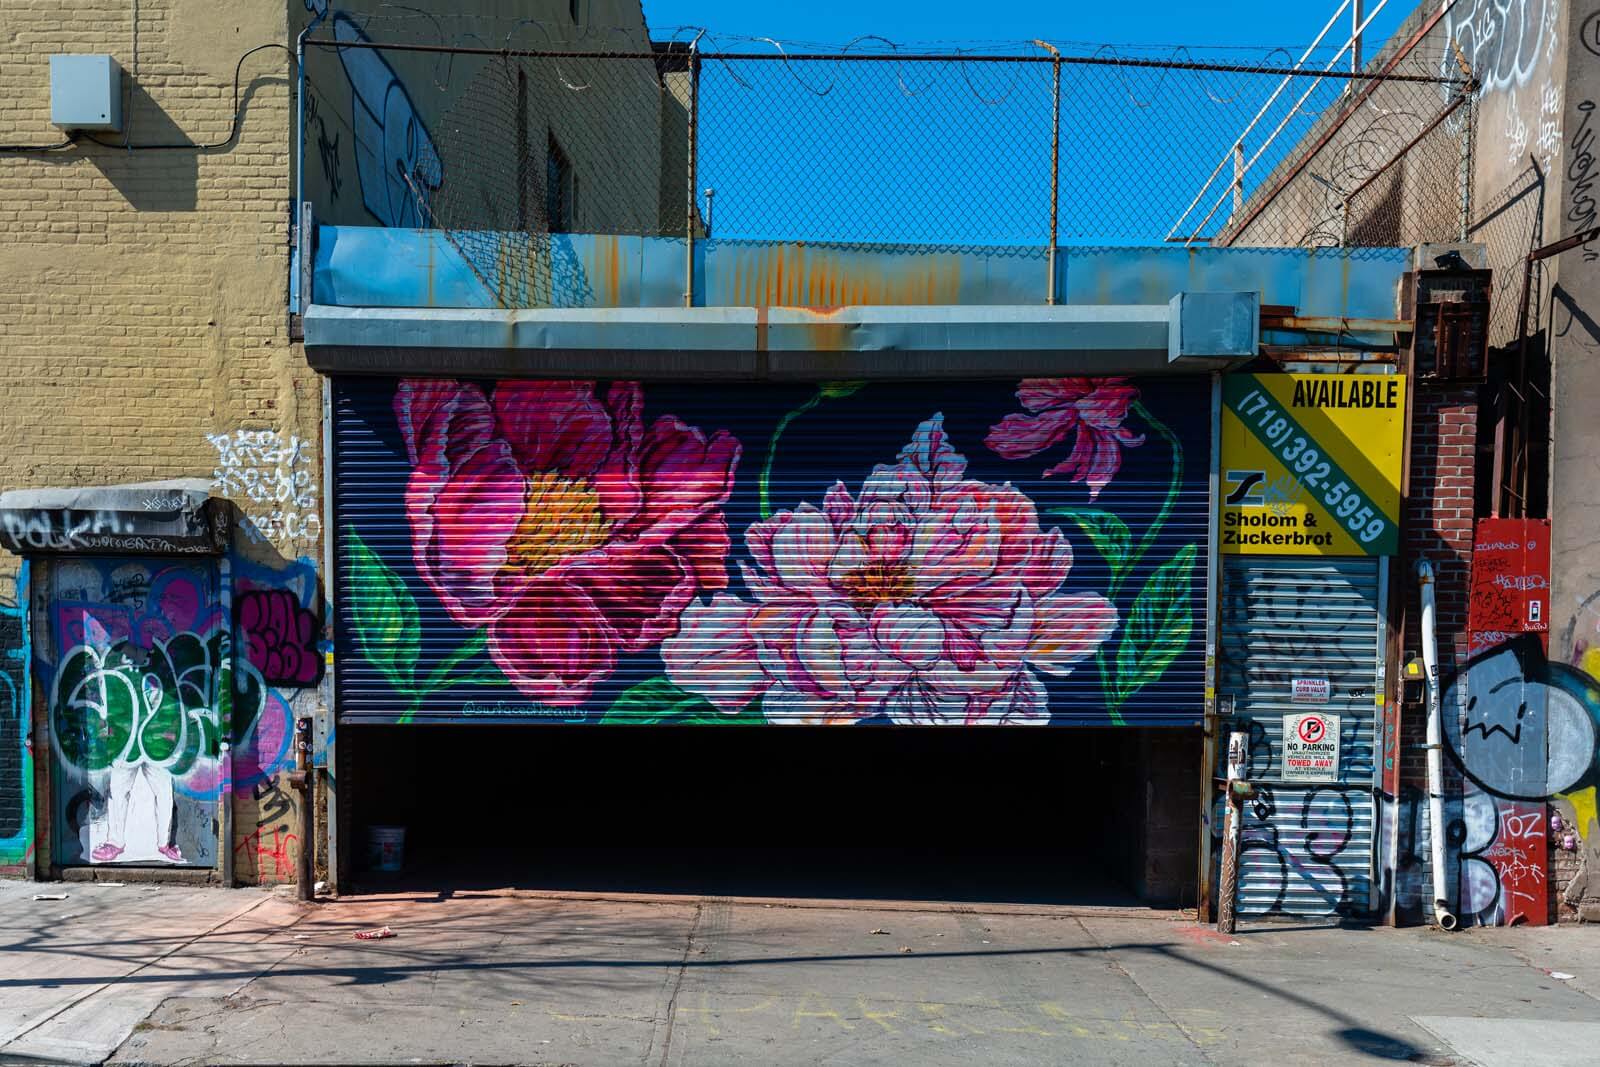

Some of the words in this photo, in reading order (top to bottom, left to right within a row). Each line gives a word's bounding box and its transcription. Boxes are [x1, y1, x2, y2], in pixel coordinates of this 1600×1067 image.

[1292, 379, 1398, 408] AVAILABLE
[1223, 512, 1297, 527] Sholom
[1303, 512, 1317, 527] &
[1223, 530, 1333, 546] Zuckerbrot
[1287, 743, 1298, 751] NO
[1302, 744, 1335, 752] PARKING
[1287, 759, 1311, 767] TOWED
